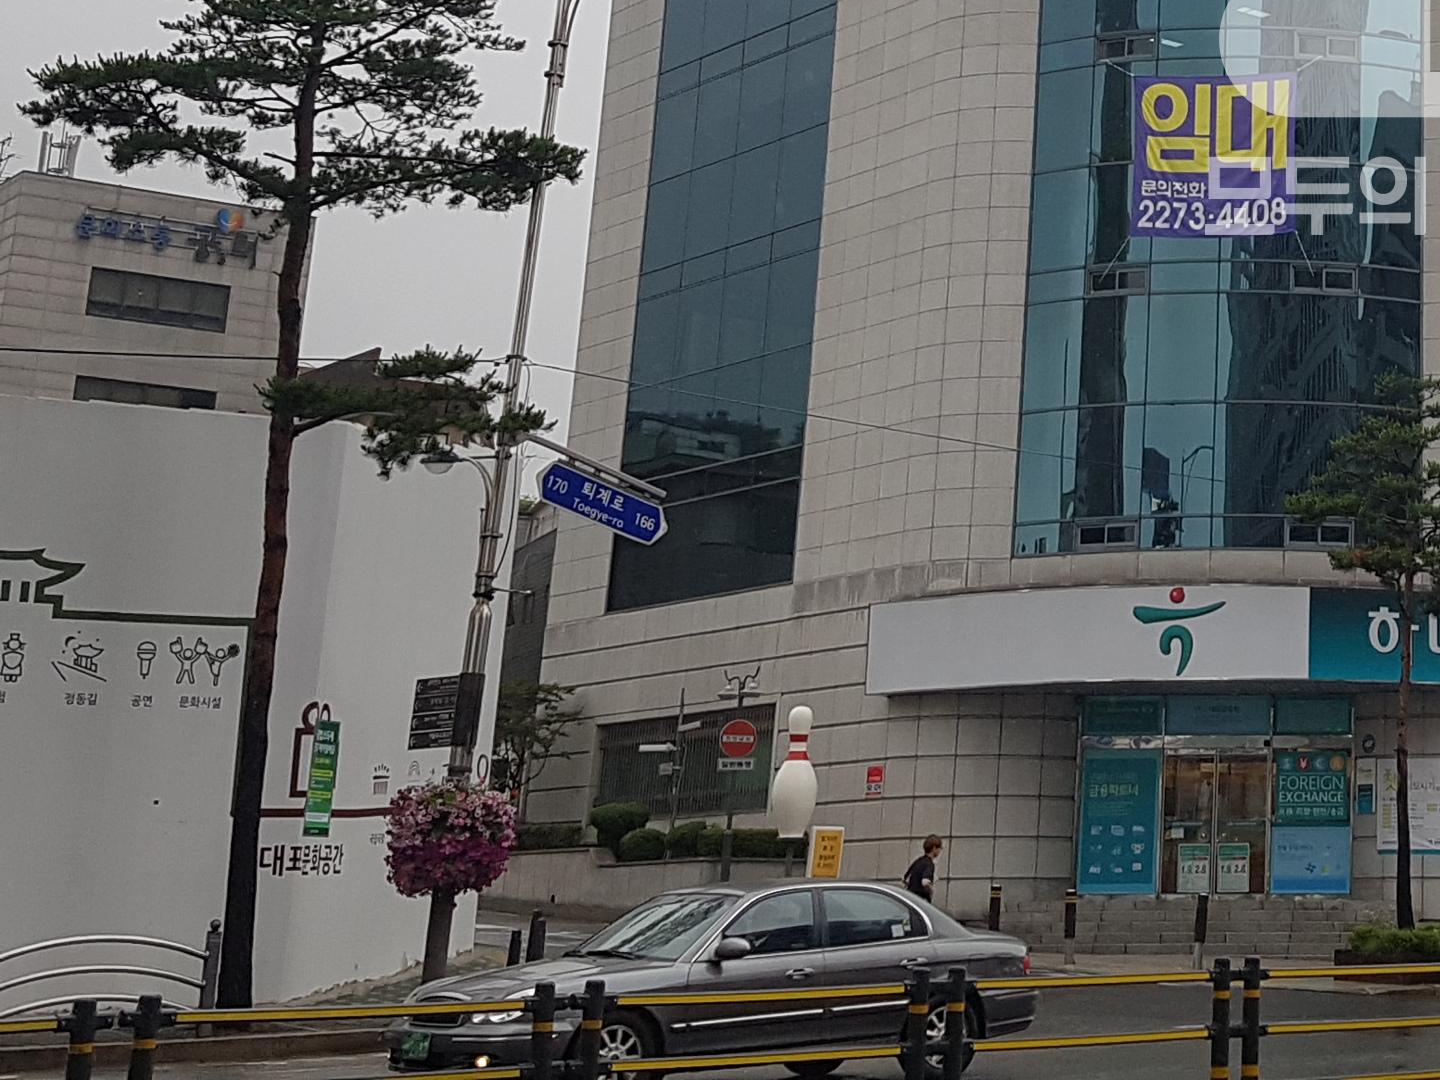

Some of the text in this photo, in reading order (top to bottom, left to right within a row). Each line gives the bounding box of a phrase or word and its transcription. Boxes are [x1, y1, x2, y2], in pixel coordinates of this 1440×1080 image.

[1141, 79, 1290, 173] 임대
[1141, 179, 1207, 199] 문의전화
[547, 475, 568, 495] 170
[581, 481, 625, 512] 퇴계로
[572, 497, 624, 528] Toegye-ro
[634, 512, 656, 531] 166
[131, 695, 153, 708] 공연
[179, 696, 222, 709] 문화시설
[1279, 775, 1345, 790] FOREIGN
[1279, 791, 1344, 803] EXCHANGE
